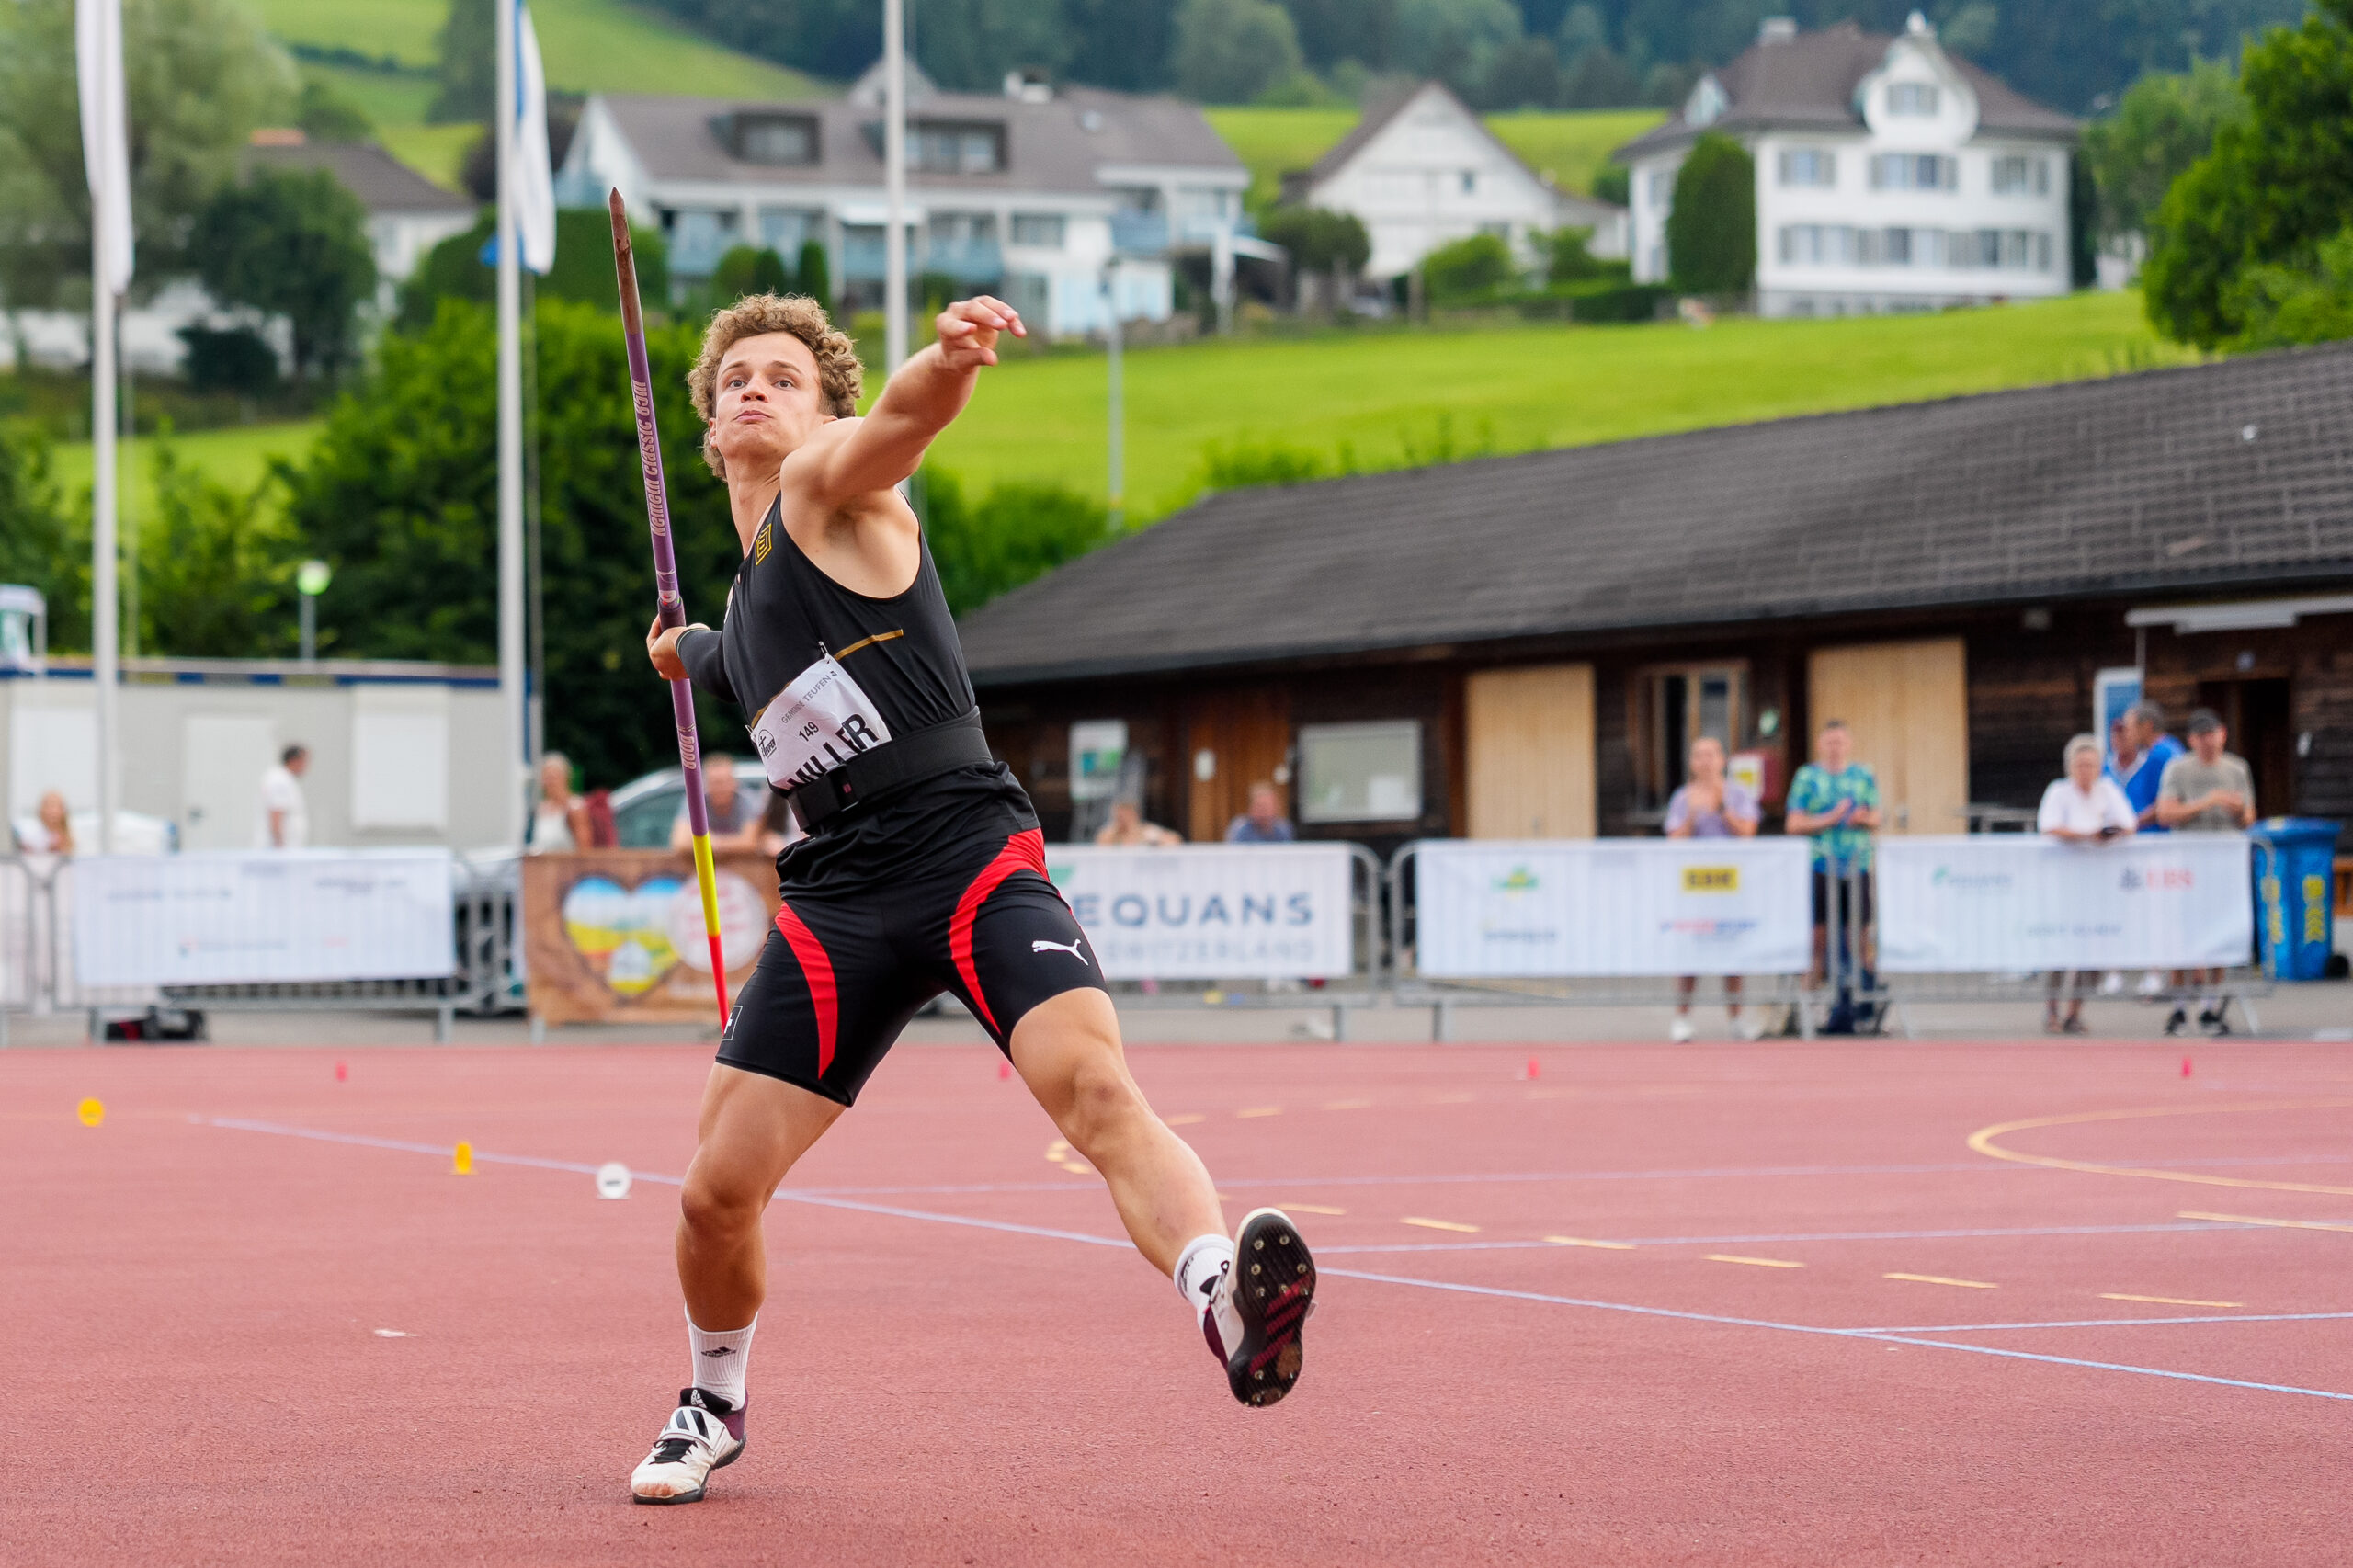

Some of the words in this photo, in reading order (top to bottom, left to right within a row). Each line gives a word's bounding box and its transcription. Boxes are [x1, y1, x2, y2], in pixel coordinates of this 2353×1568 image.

[802, 675, 831, 702] TEUFEN
[799, 722, 820, 742] 149
[1073, 892, 1315, 929] EQUANS
